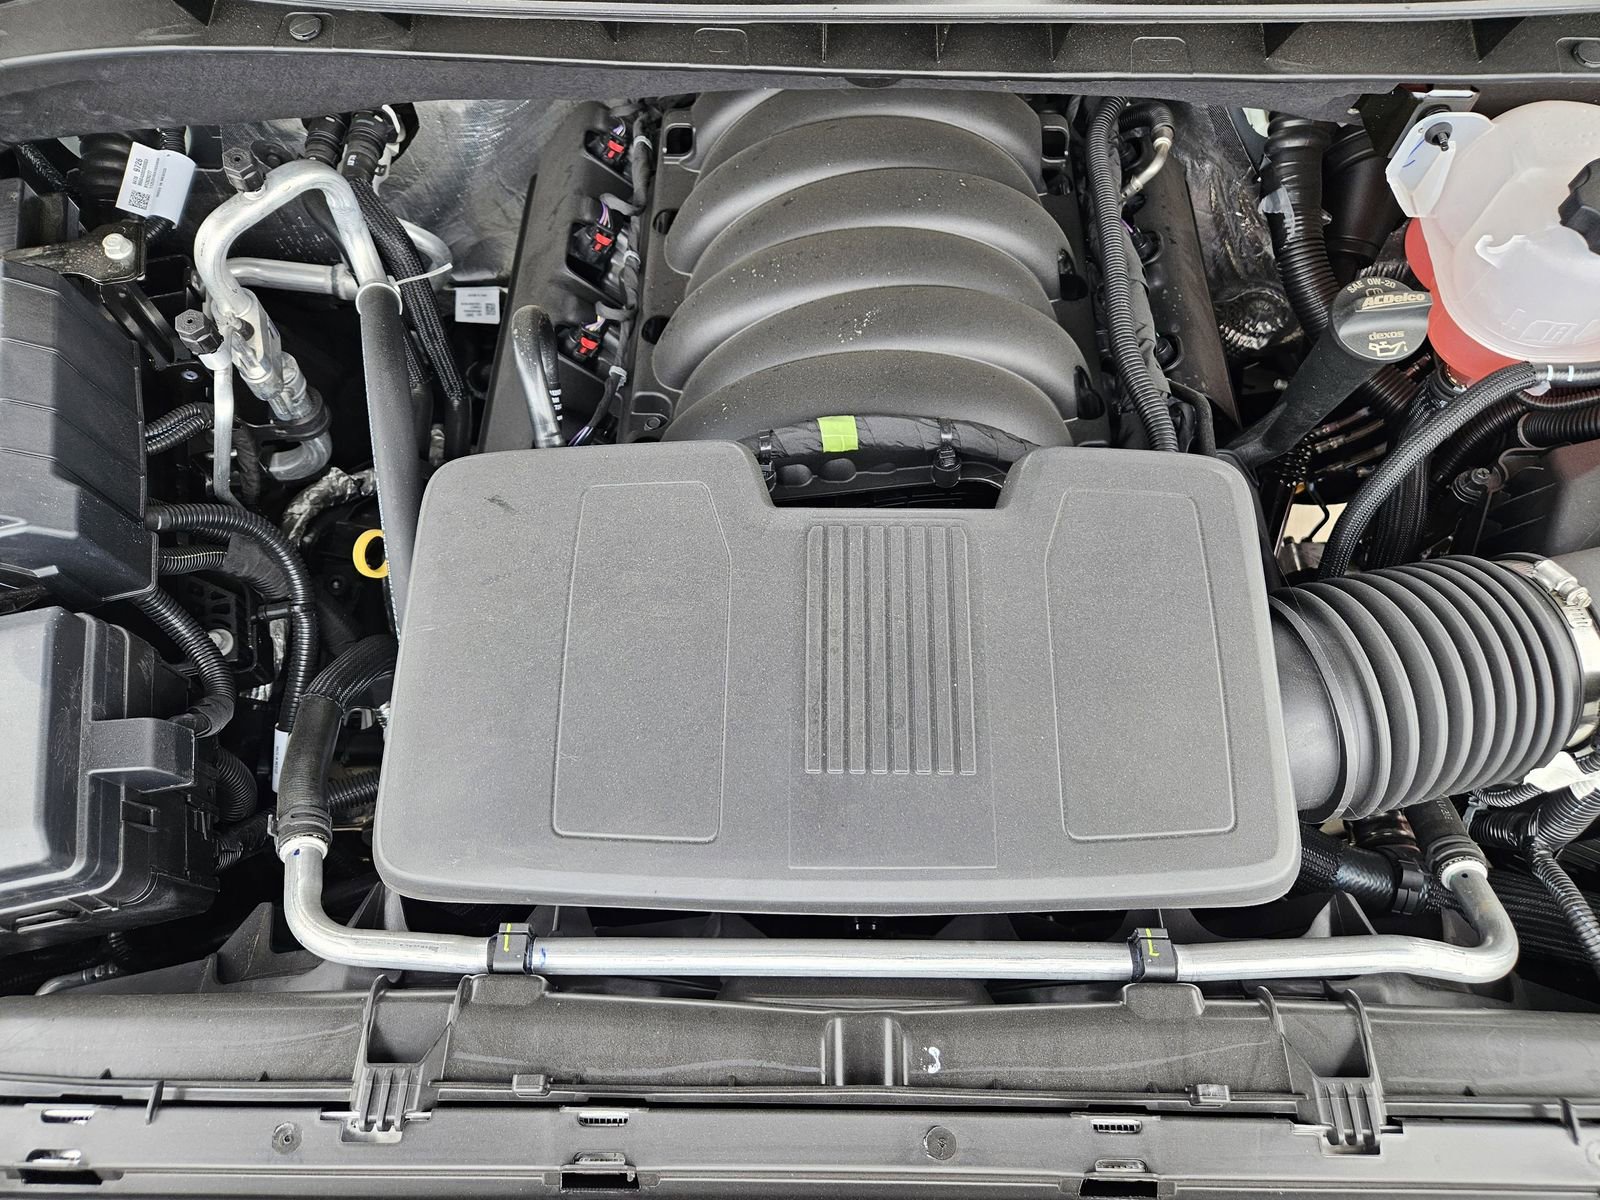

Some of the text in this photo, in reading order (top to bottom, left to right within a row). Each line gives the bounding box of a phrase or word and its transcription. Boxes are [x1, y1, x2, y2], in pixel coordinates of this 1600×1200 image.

[1347, 278, 1396, 294] SAE 0W-20
[1361, 293, 1425, 307] ACDelco
[1368, 330, 1405, 341] dexos
